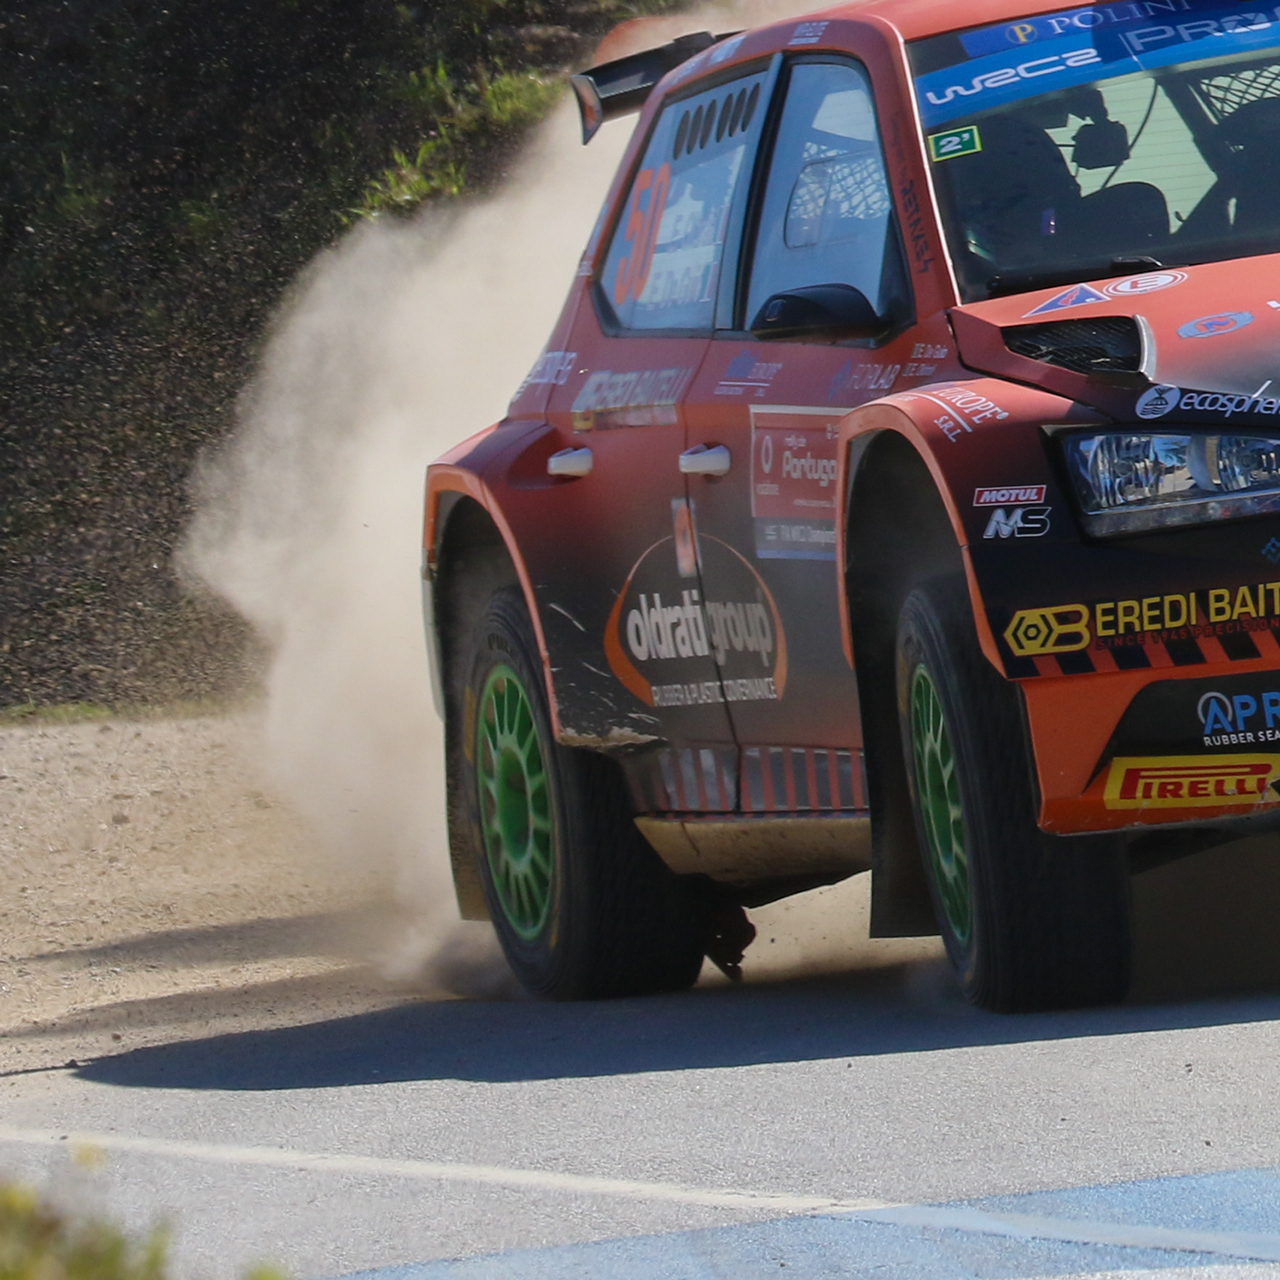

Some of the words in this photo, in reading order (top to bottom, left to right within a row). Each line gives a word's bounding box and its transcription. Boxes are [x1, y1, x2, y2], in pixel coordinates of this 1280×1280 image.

[614, 162, 671, 306] 50
[782, 450, 837, 488] Portuga
[979, 487, 1040, 503] MOTUL
[1094, 592, 1197, 638] EREDI
[1095, 634, 1145, 650] SINCE
[1194, 618, 1280, 638] PRECISION
[1202, 732, 1256, 748] RUBBER
[1119, 763, 1273, 801] PIRELLI
